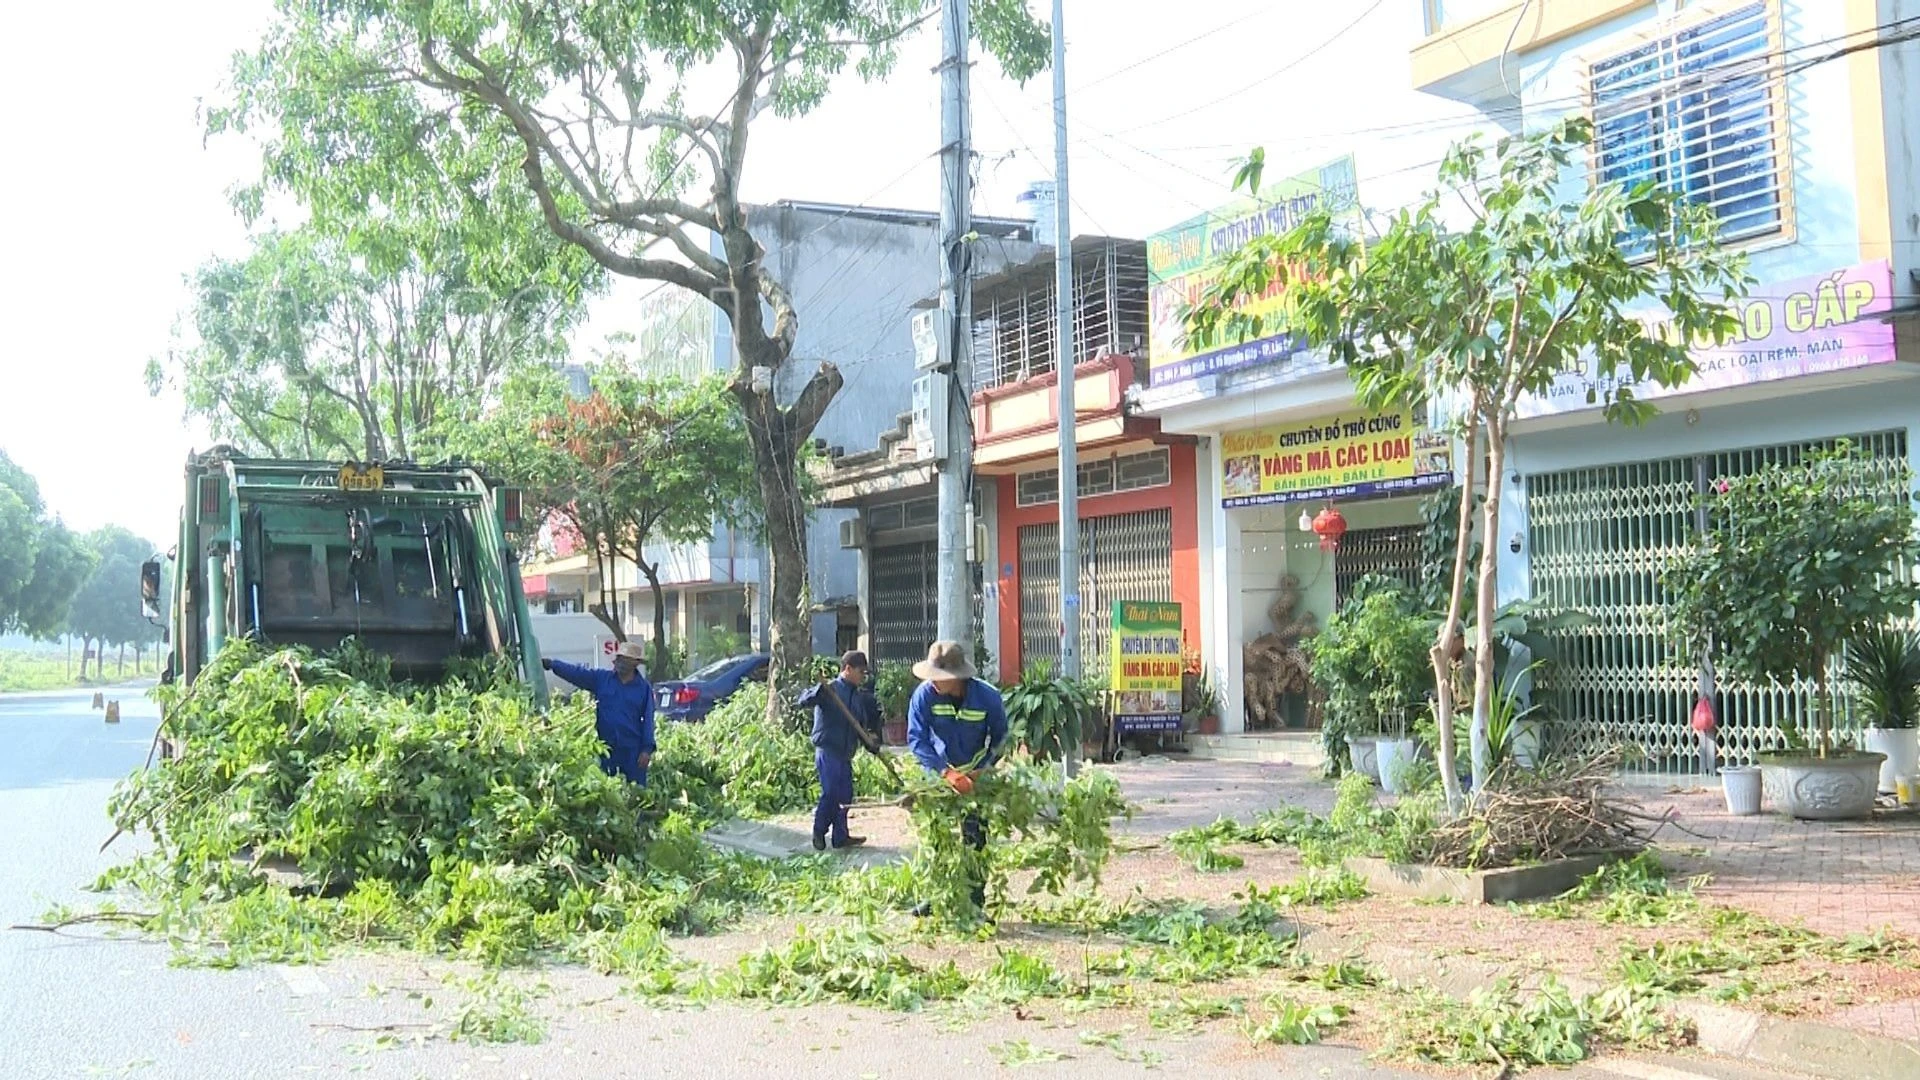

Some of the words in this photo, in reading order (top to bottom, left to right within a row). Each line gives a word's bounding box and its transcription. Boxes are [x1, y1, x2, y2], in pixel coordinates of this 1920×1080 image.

[1784, 269, 1875, 333] CẤP
[1280, 425, 1322, 447] CHUYÊN
[1368, 412, 1401, 433] CÚNG
[1264, 452, 1303, 477] VÀNG
[1307, 446, 1332, 472] MÃ
[1336, 442, 1368, 468] CÁC
[1373, 436, 1411, 464] LOẠI
